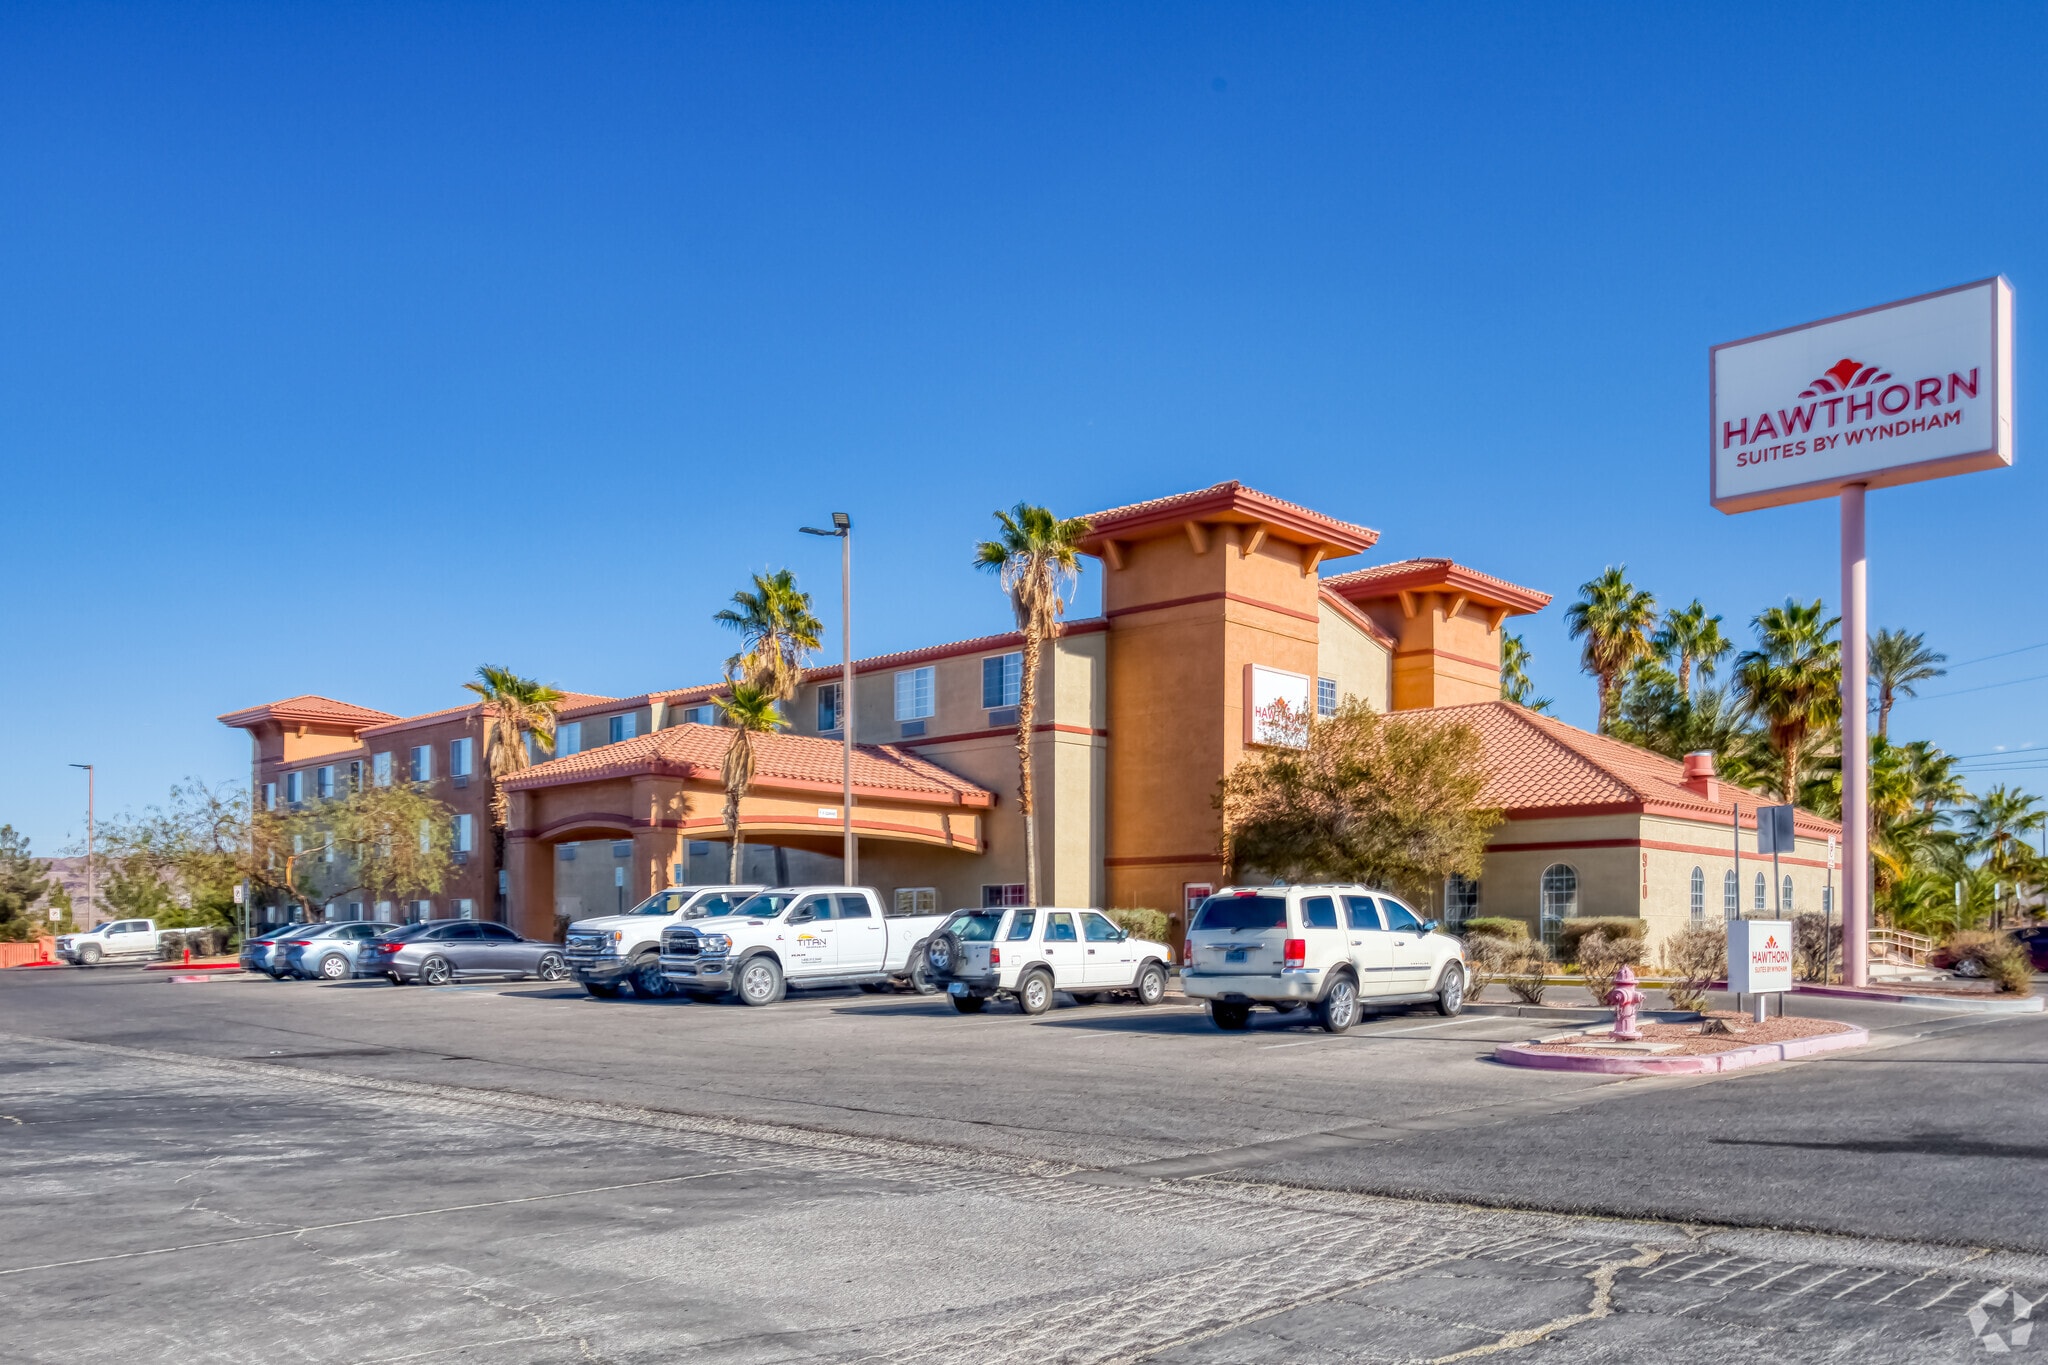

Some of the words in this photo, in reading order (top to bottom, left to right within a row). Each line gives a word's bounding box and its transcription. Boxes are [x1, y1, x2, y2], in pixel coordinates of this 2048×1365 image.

[1723, 367, 1980, 449] HAWTHORN
[1736, 440, 1807, 468] SUITES
[1813, 433, 1840, 453] BY
[1844, 409, 1962, 446] WYNDHAM
[797, 938, 827, 947] TITAN
[1752, 951, 1790, 964] HAWTHORN
[1754, 966, 1767, 974] SUITES
